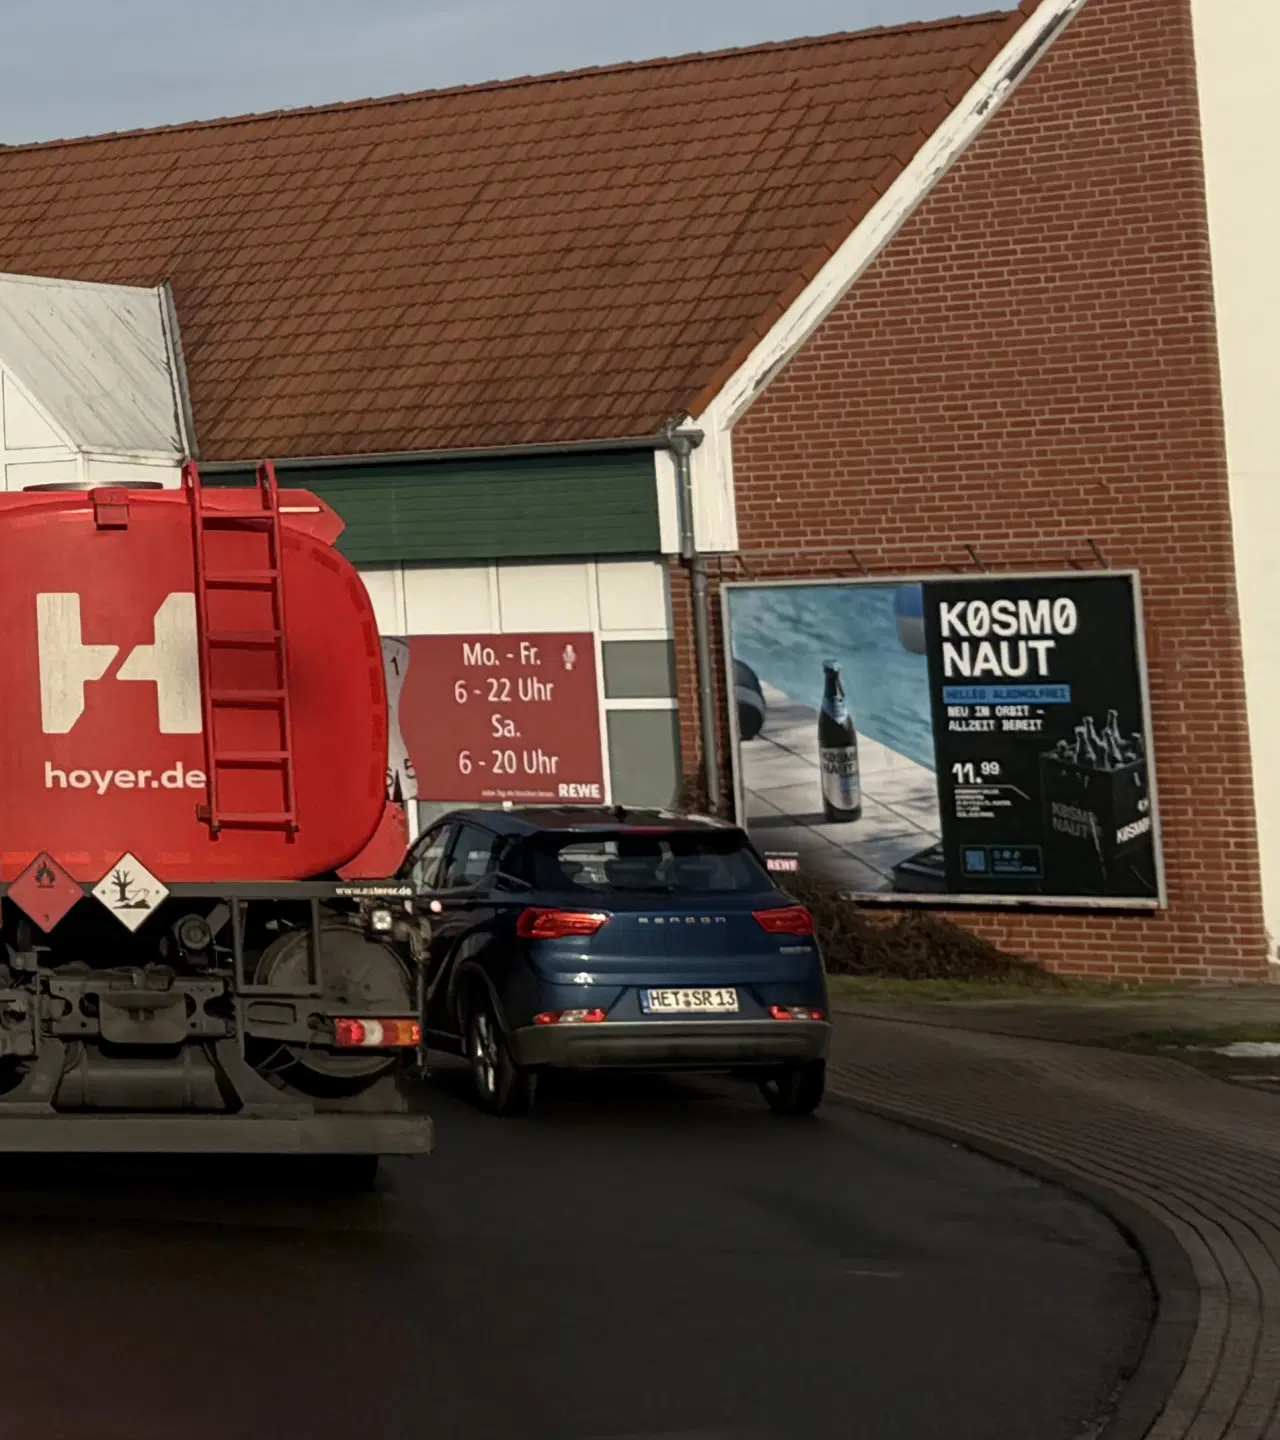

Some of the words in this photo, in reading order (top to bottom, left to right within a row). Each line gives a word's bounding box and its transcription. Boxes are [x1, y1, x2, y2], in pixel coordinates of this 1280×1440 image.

[462, 642, 500, 667] Mo.
[520, 641, 541, 665] Fr.
[942, 639, 1057, 678] NAUT
[454, 679, 468, 704] 6
[486, 677, 512, 702] 22
[518, 675, 555, 702] Uhr
[947, 705, 969, 717] NEU
[974, 705, 991, 717] IN
[994, 704, 1030, 717] ORBIT
[491, 713, 522, 738] Sa.
[948, 719, 996, 732] ALLZEIT
[1001, 719, 1043, 732] BEREIT
[459, 749, 472, 775] 6
[492, 749, 517, 774] 20
[523, 748, 559, 774] Uhr
[44, 760, 208, 796] hoyer.de
[558, 783, 601, 799] REWE
[649, 990, 681, 1007] HET
[692, 991, 712, 1006] SR
[716, 990, 736, 1006] 13
